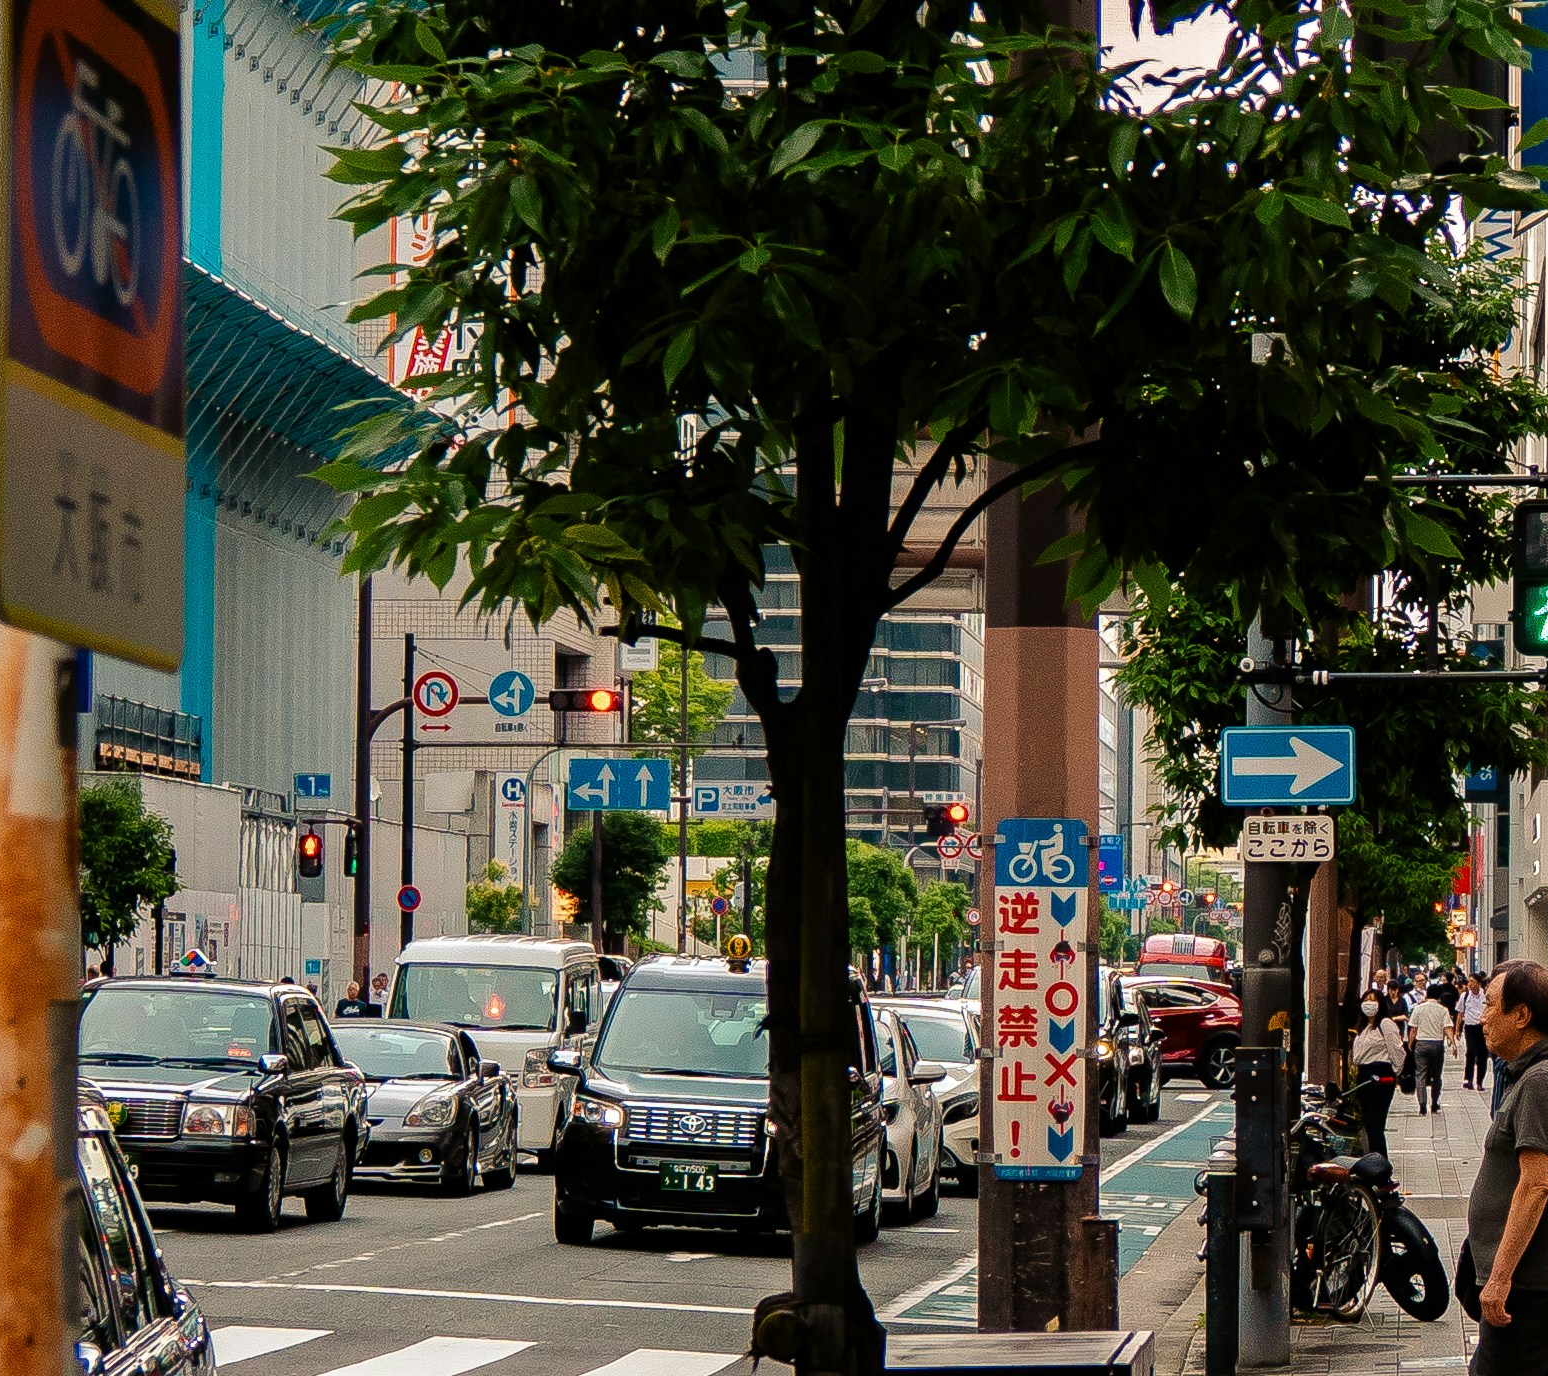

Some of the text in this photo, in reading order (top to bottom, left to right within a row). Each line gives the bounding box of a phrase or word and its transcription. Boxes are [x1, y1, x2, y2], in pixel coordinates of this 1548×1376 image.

[1248, 820, 1329, 836] 自転車を除く
[1247, 837, 1330, 858] ここから
